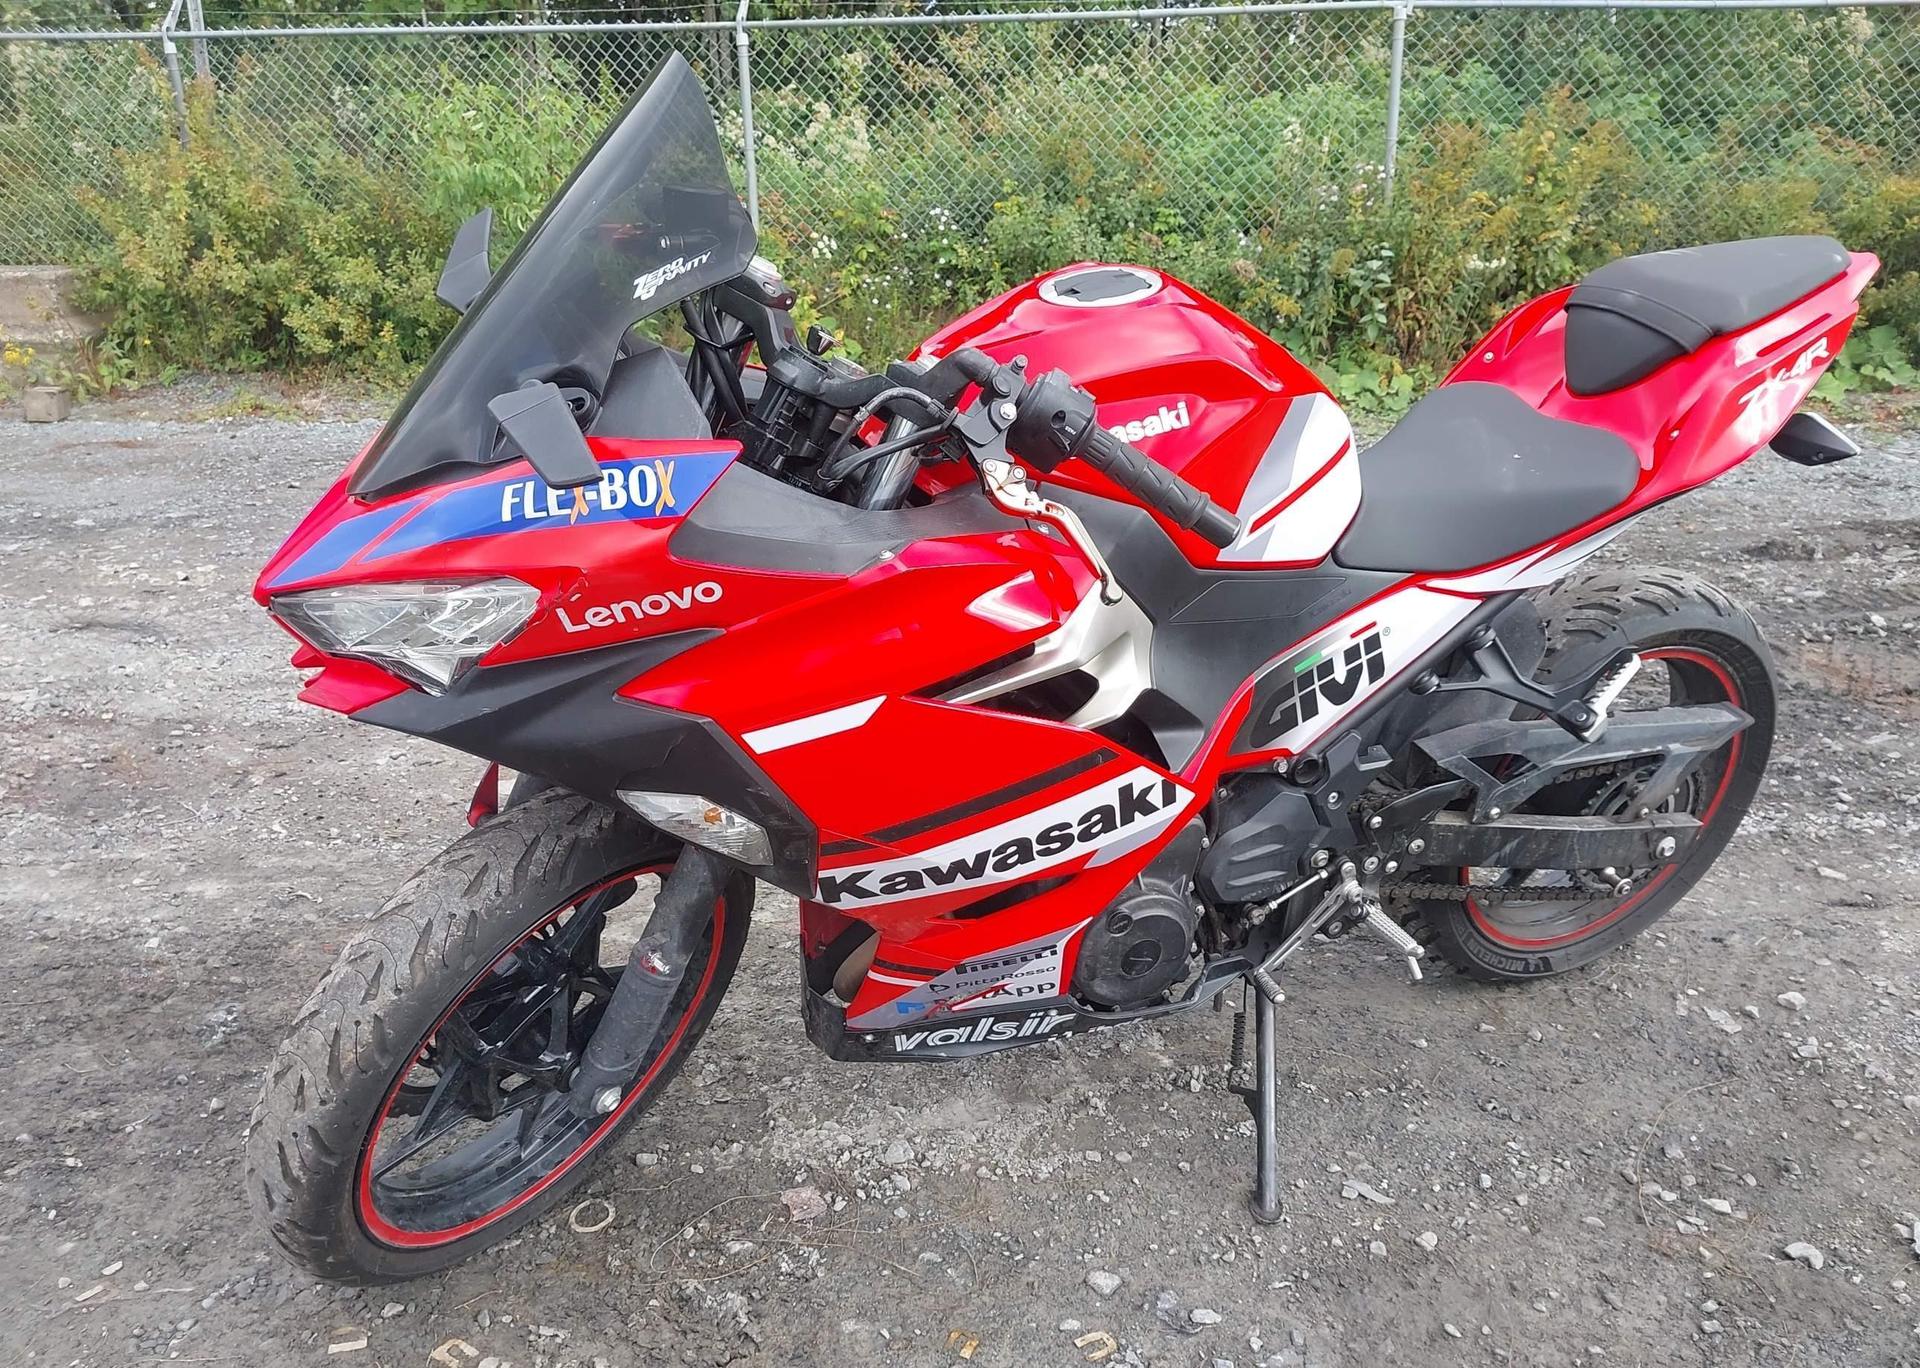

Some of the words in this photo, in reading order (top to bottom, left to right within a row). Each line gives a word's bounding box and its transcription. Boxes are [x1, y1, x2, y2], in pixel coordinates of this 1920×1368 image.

[632, 256, 684, 300] ZERO
[640, 251, 712, 301] GRAVITY
[1108, 400, 1191, 444] asaki
[501, 459, 676, 525] FLEX-BOX
[555, 581, 724, 634] Lenovo
[817, 778, 1178, 904] Kawasaki
[954, 944, 1058, 975] PIRELLI
